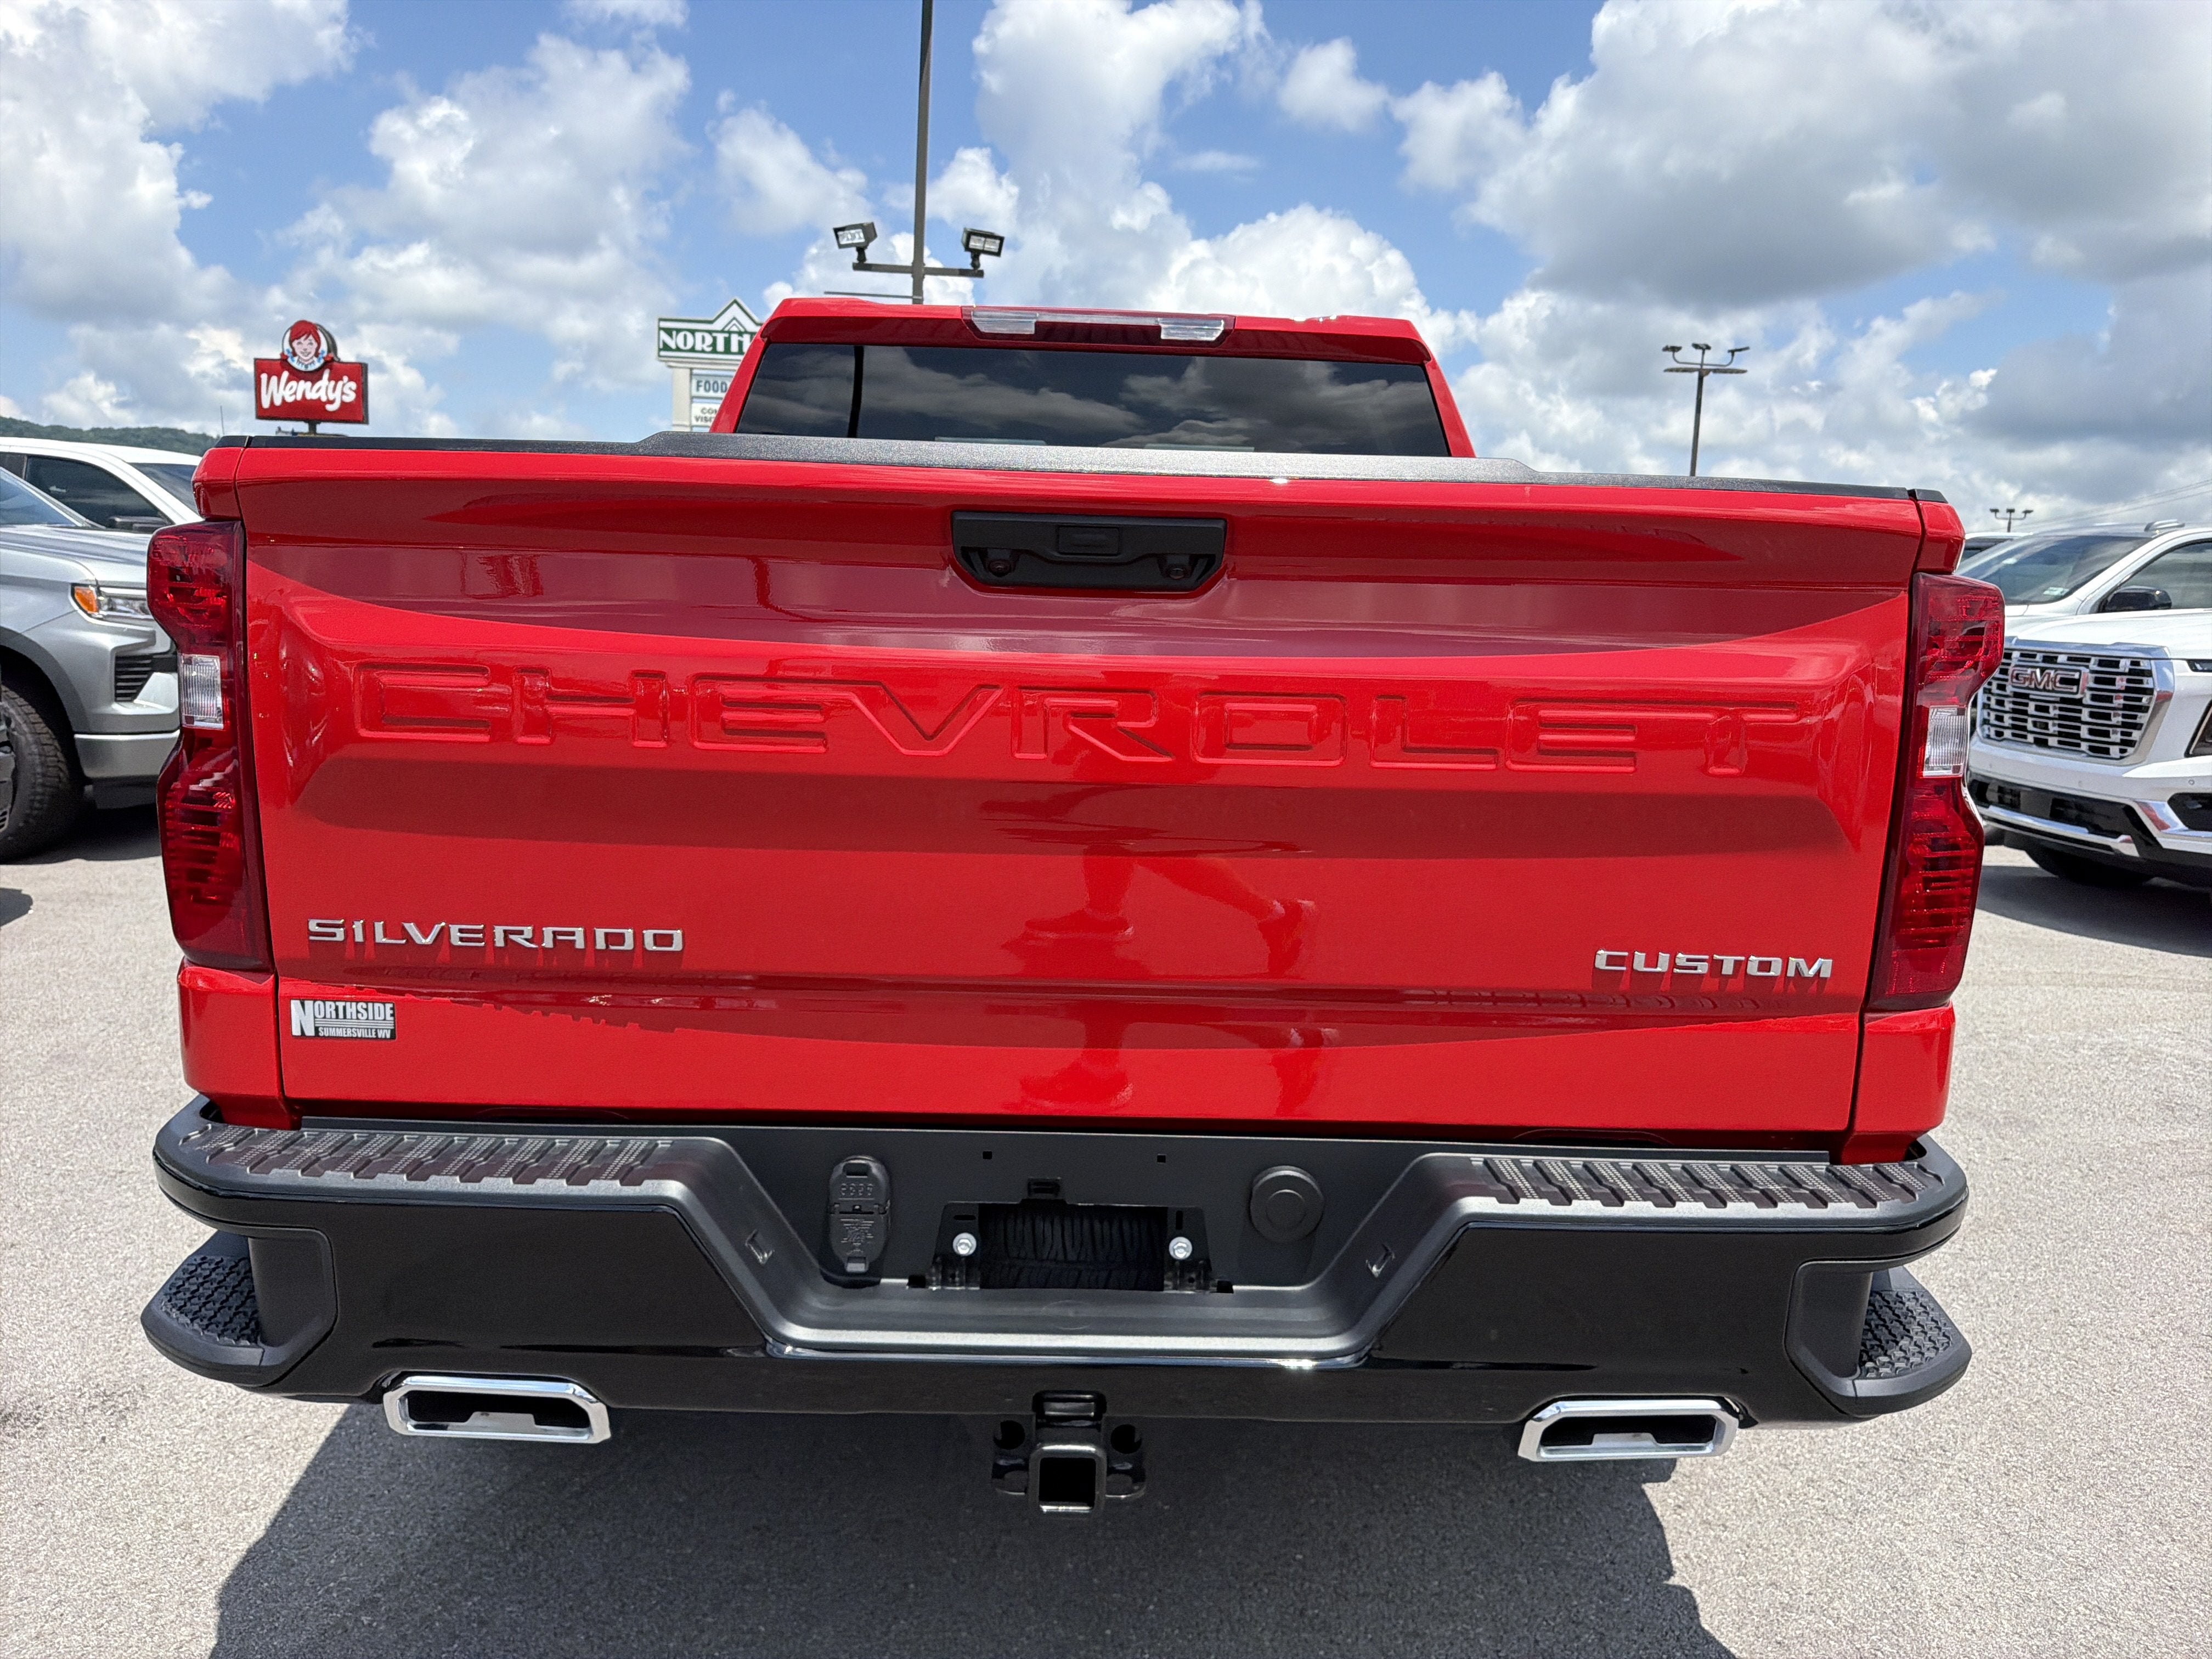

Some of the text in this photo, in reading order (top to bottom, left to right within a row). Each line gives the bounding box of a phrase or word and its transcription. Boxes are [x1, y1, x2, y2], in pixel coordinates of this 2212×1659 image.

[261, 369, 357, 411] Wendy's
[696, 380, 727, 393] FOOD
[2011, 666, 2079, 692] GMC
[355, 662, 1800, 775] CHEVROLET
[307, 918, 684, 952] SILVERADO
[1594, 949, 1833, 978] CUSTOM
[291, 999, 394, 1036] NORTHSIDE
[318, 1026, 391, 1039] SUMMERSVILLE WV
